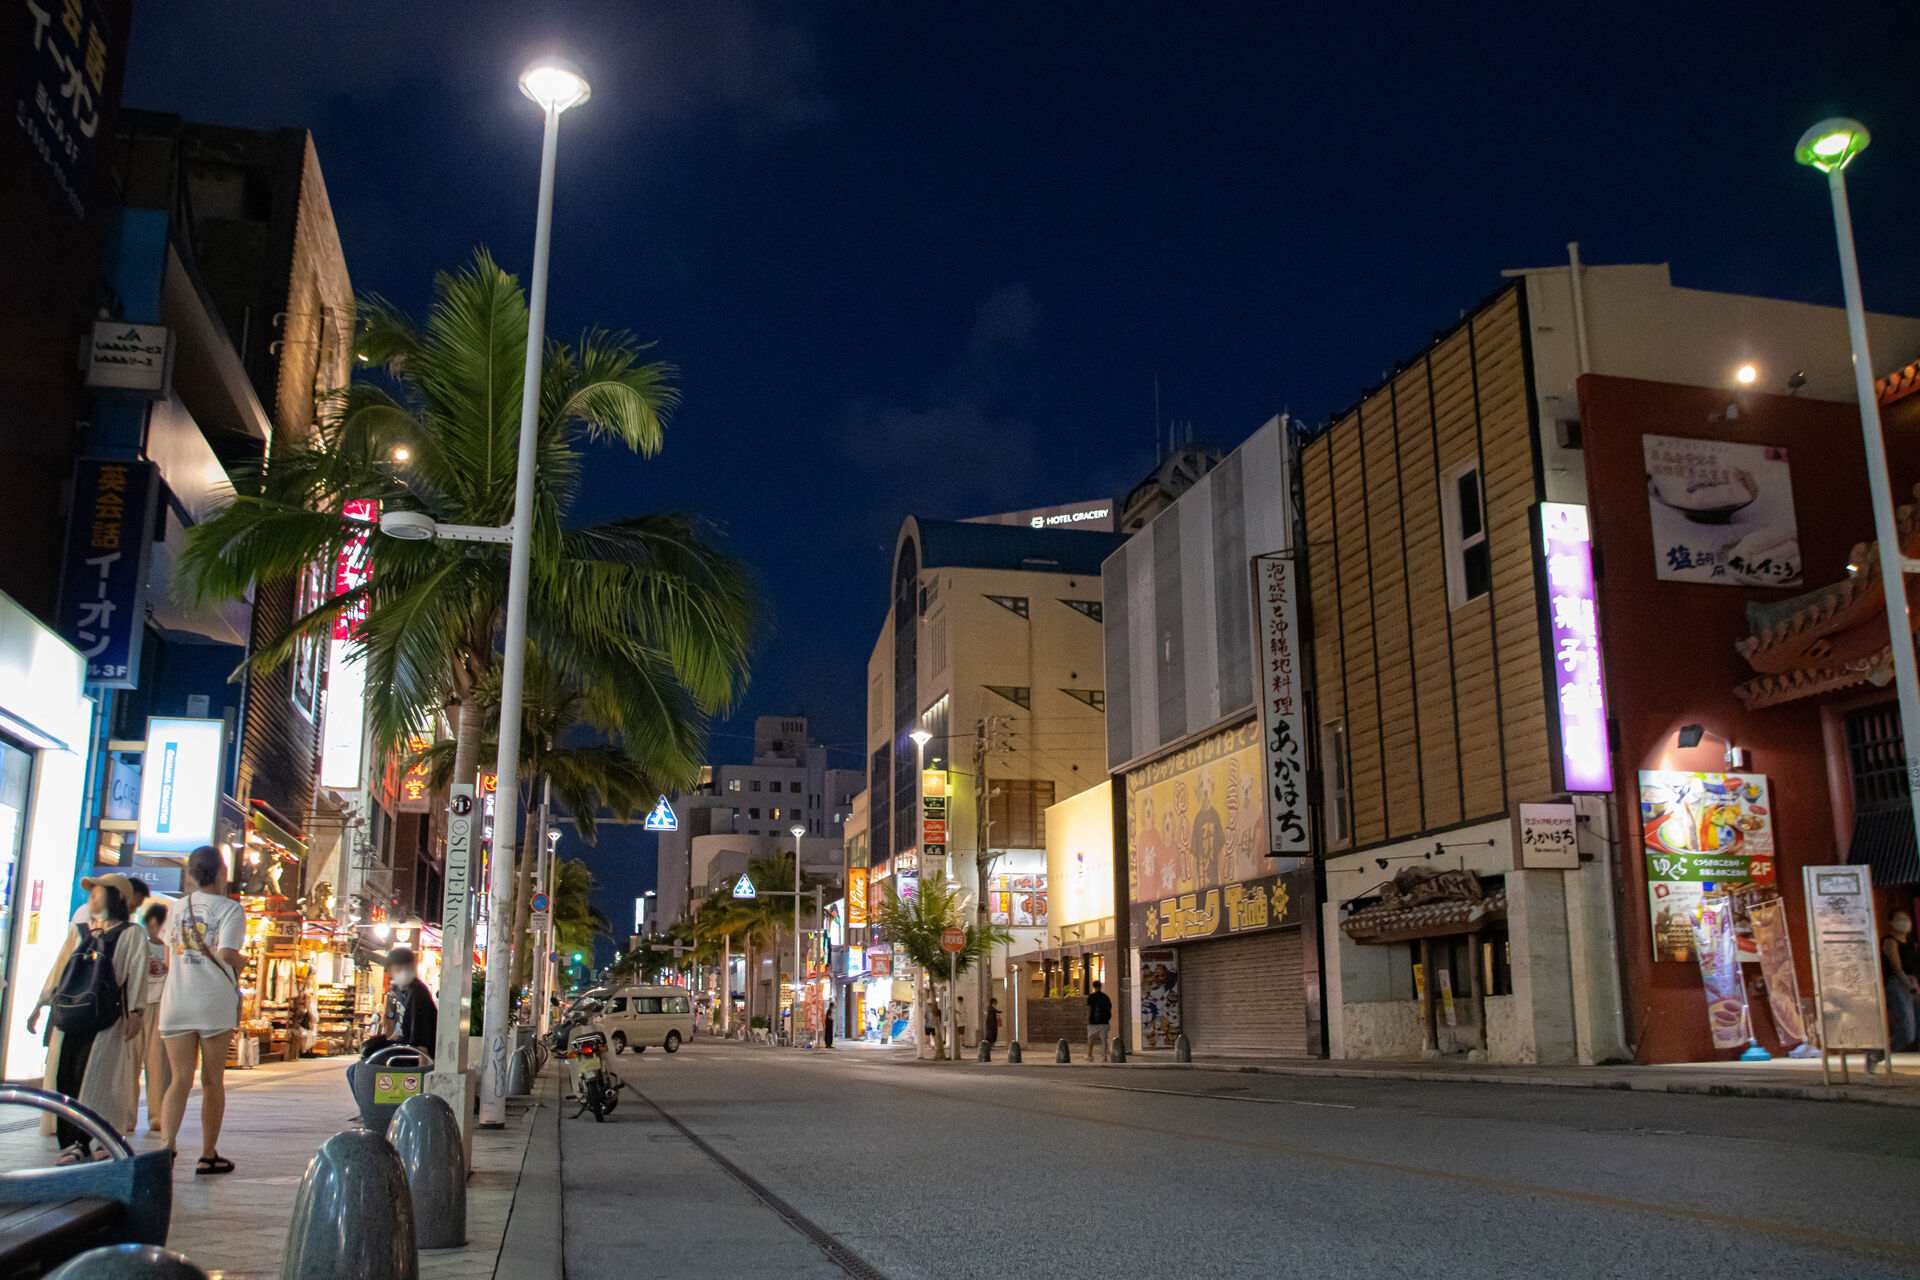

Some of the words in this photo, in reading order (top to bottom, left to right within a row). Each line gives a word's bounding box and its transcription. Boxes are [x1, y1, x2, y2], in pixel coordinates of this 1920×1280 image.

[91, 464, 128, 548] 英会話
[1046, 514, 1072, 525] HOTEL
[1072, 509, 1109, 522] GRACERY
[77, 551, 122, 658] イーオン
[1270, 719, 1306, 843] あかはち
[1523, 827, 1575, 845] あかはち
[1751, 861, 1772, 876] 2F
